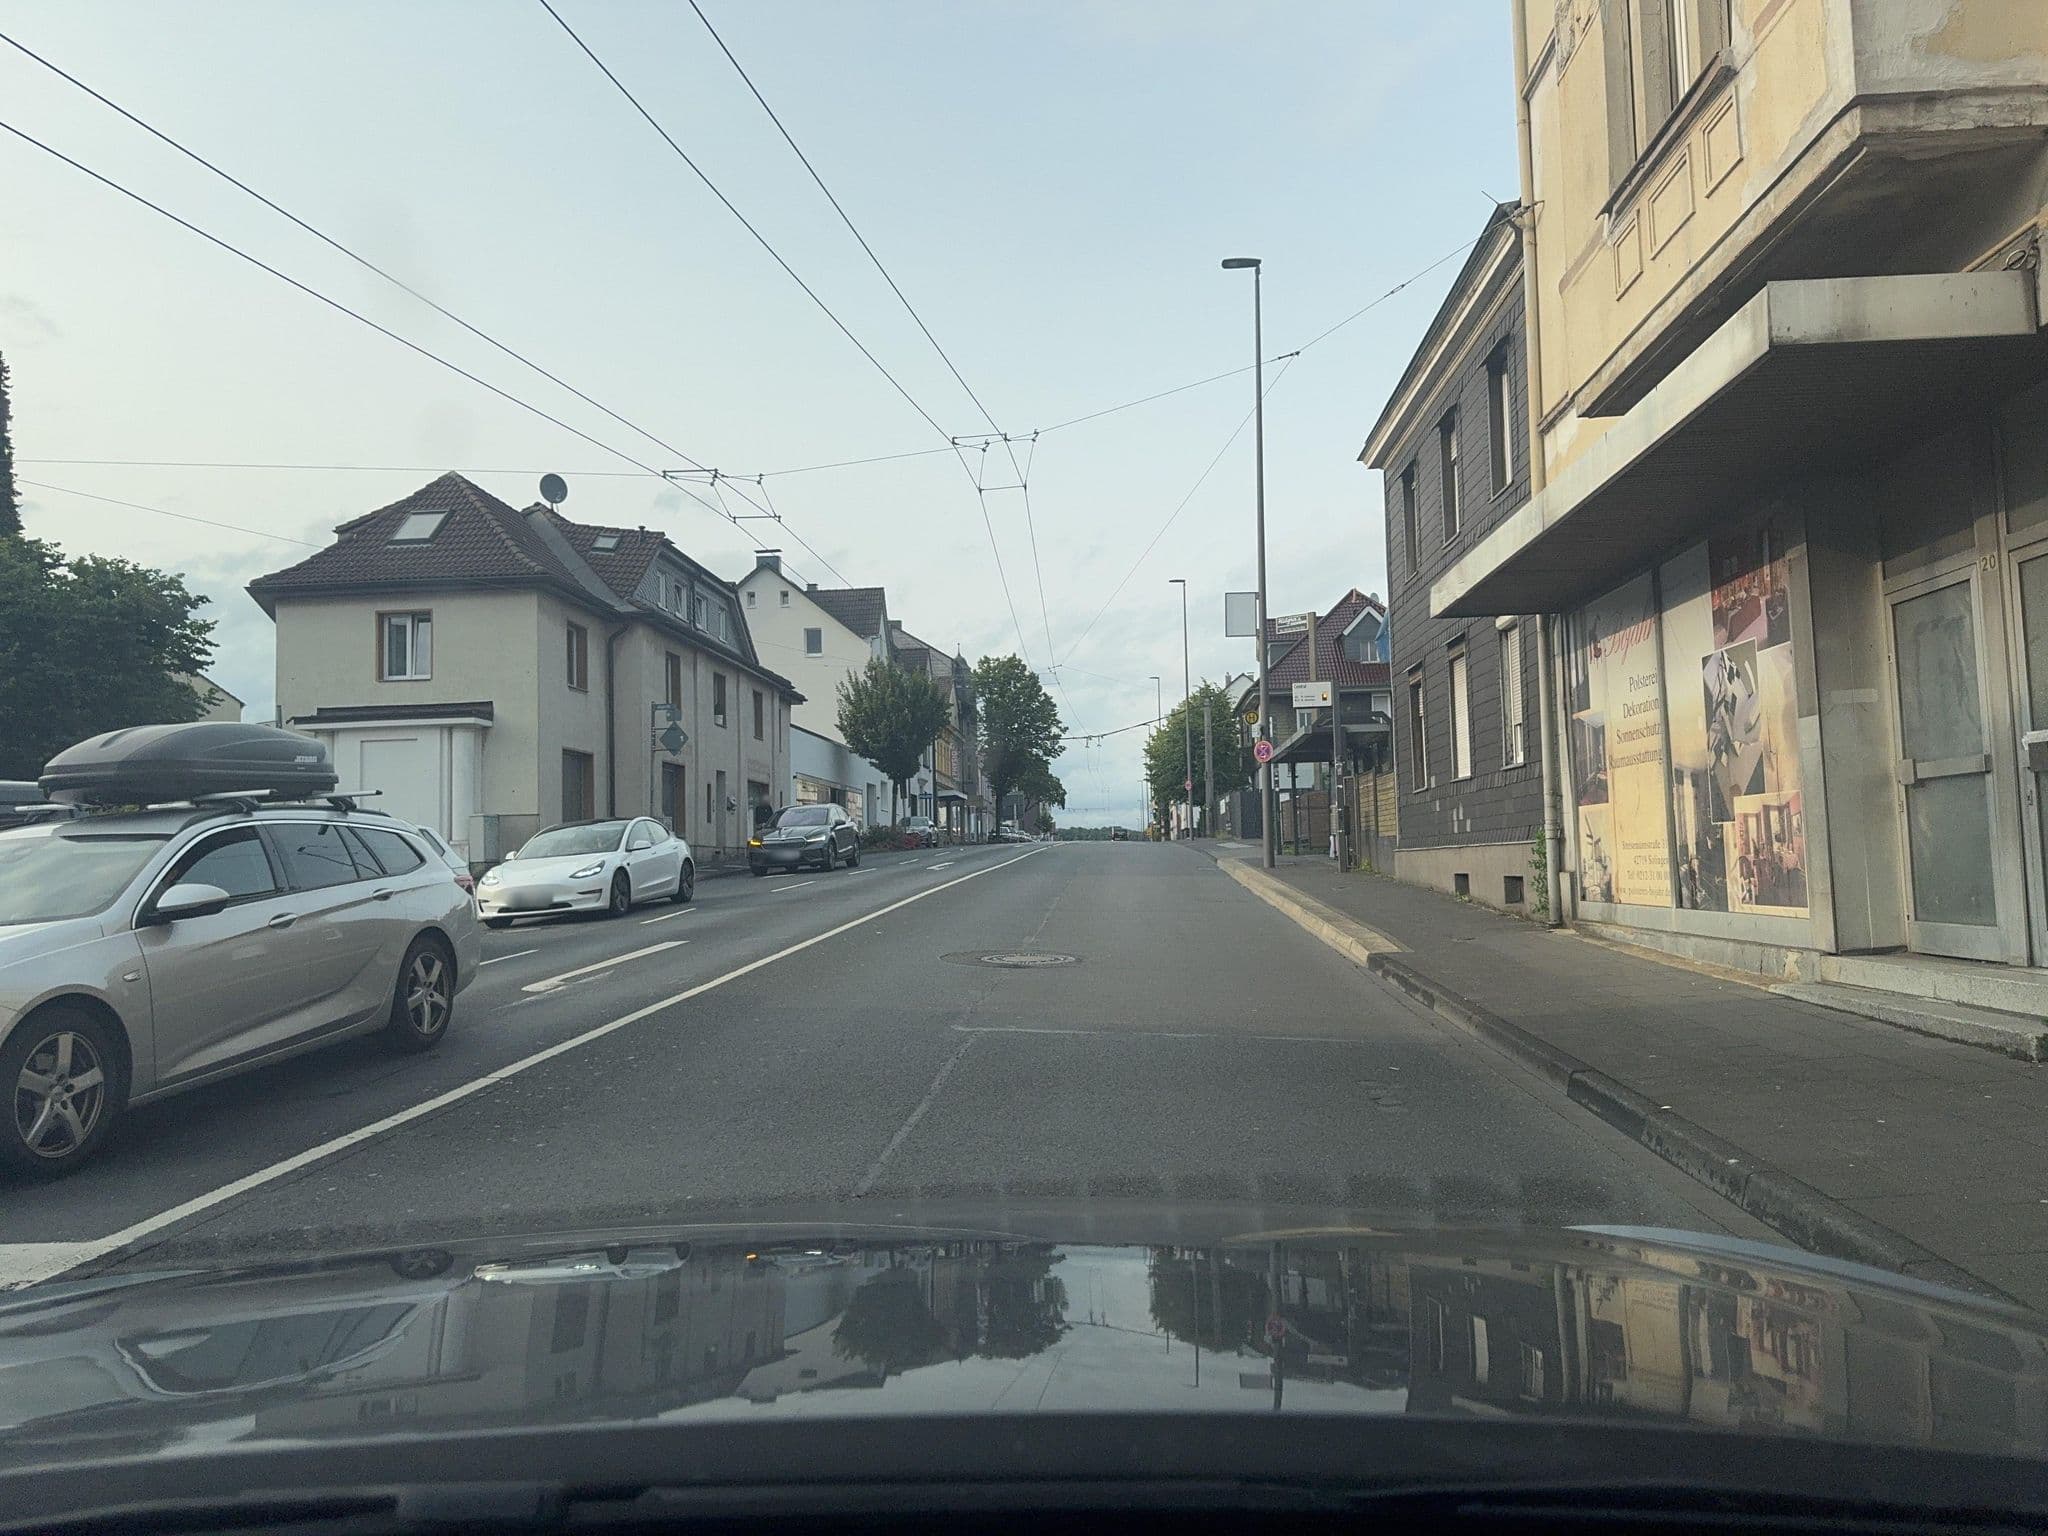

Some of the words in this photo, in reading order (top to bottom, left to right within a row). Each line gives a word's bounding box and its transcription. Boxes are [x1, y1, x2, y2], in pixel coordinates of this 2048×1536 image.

[1981, 555, 1996, 572] 20
[1629, 668, 1658, 692] Polsterei
[1623, 696, 1661, 719] Dekoration
[1616, 721, 1664, 745] Sonnenschutz
